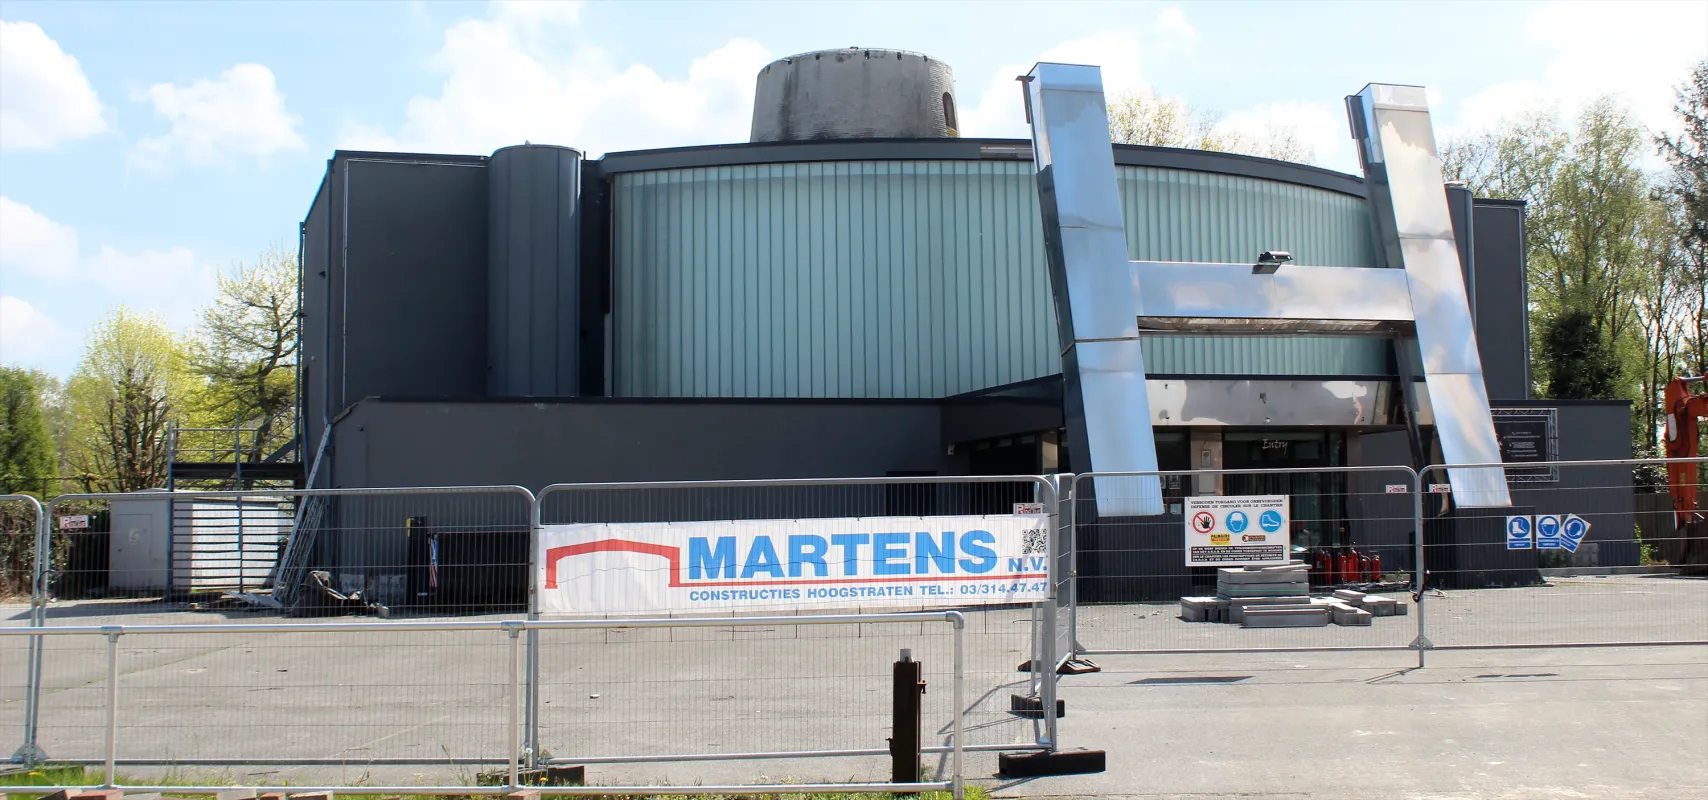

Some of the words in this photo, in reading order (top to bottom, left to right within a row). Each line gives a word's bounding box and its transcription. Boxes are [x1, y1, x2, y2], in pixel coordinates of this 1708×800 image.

[1262, 438, 1288, 455] Entry
[689, 530, 998, 580] MARTENS
[1008, 557, 1047, 572] N.V.
[689, 588, 800, 601] CONSTRUCTIES
[807, 586, 912, 598] HOOGSTRATEN
[920, 585, 954, 596] TEL.:
[960, 582, 1047, 595] 03/314.47.47
